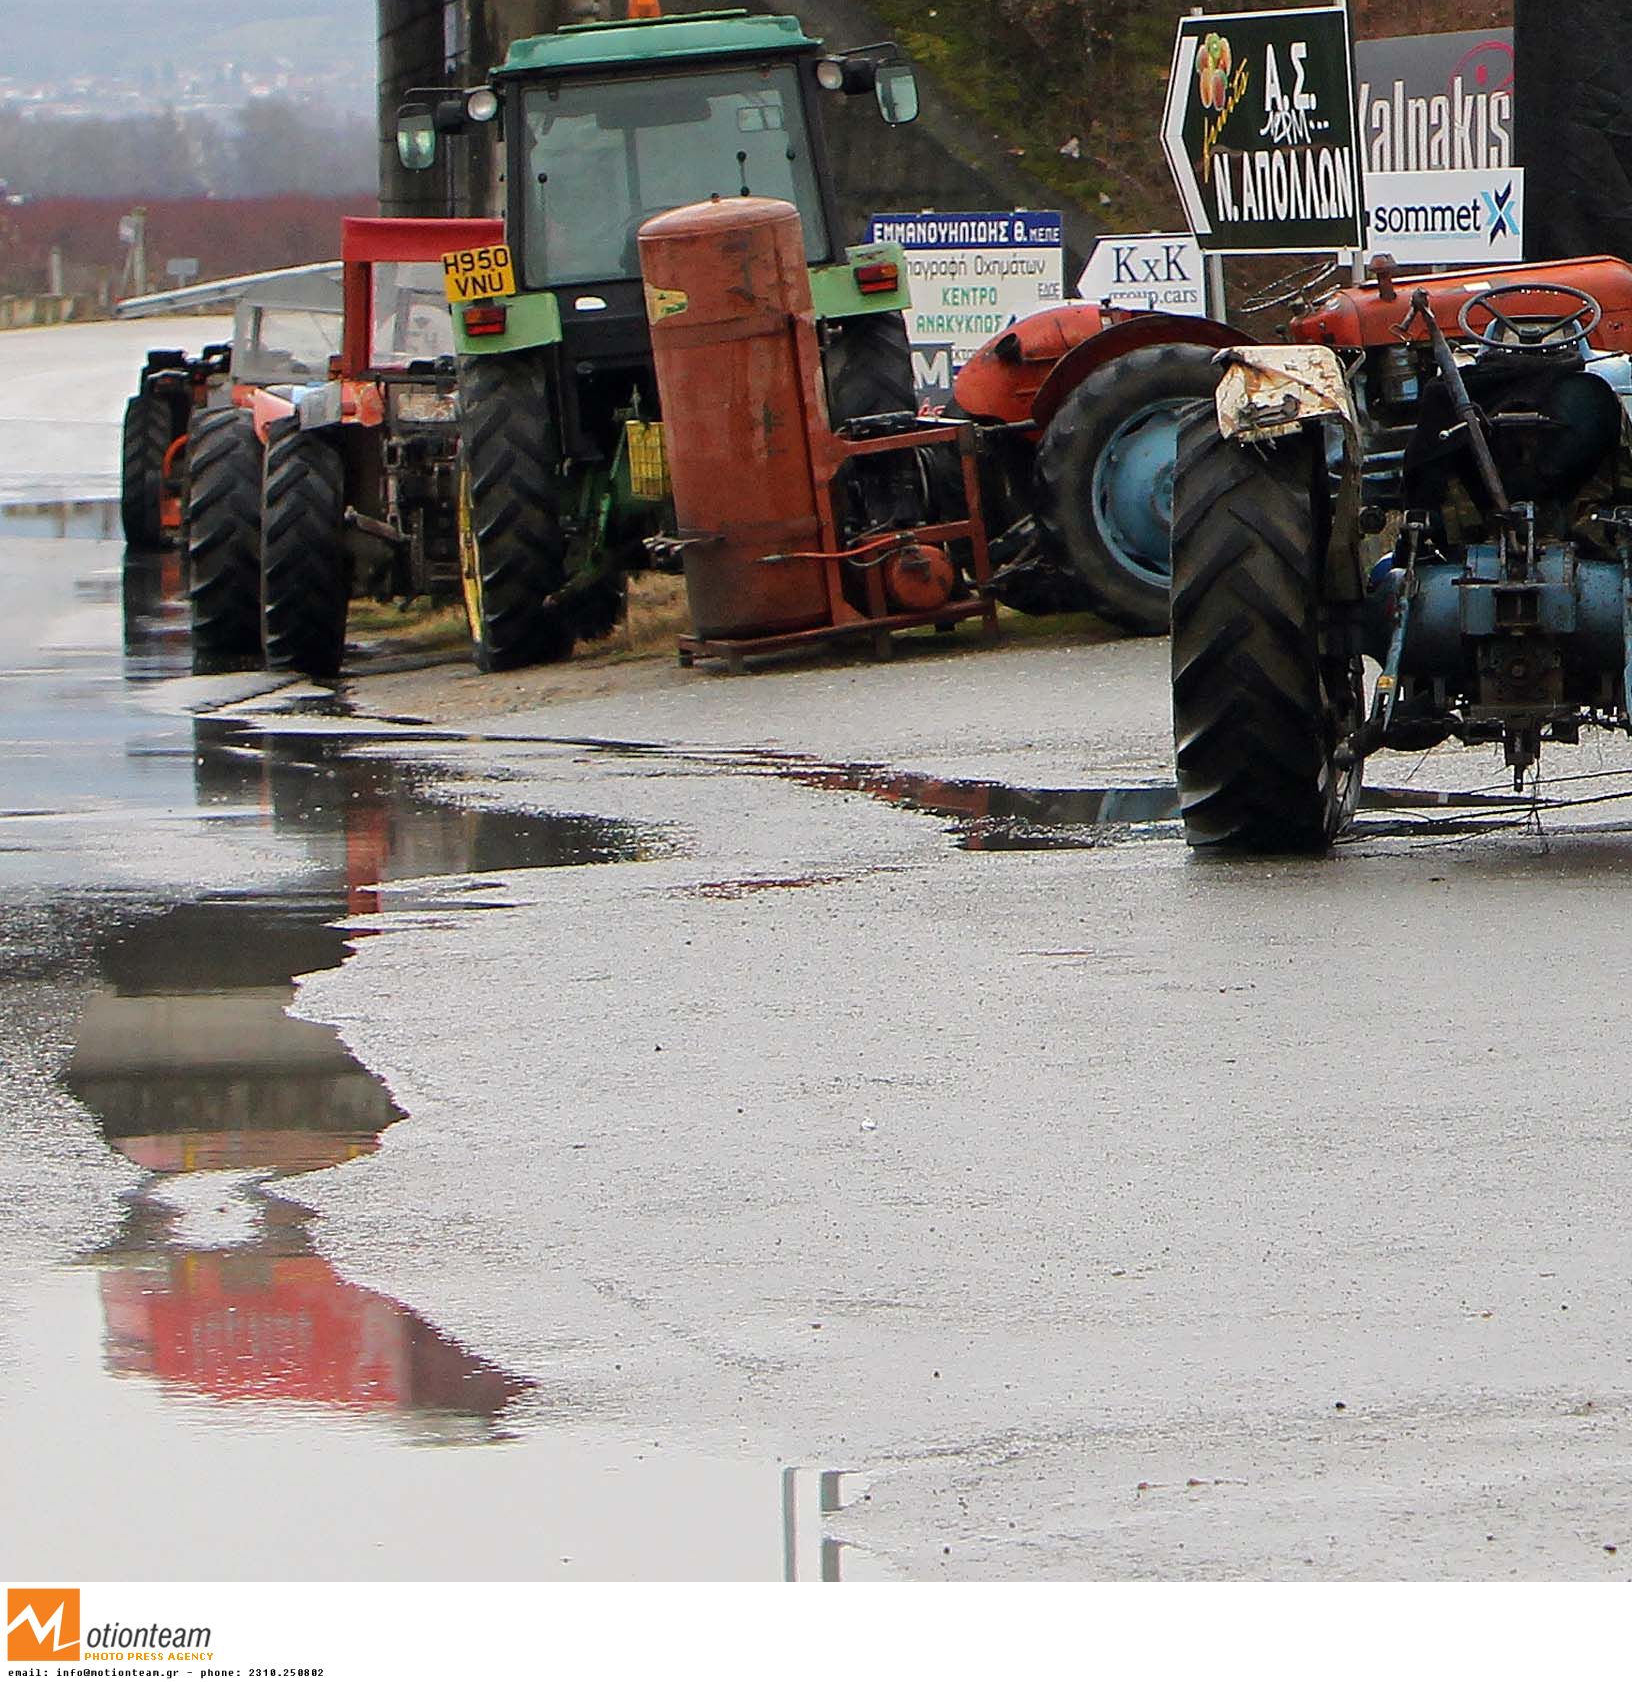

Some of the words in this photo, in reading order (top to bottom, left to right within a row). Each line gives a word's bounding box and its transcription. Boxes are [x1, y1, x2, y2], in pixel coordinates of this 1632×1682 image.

[1243, 147, 1354, 222] ΑΠΟΛΛΩΝ
[443, 247, 509, 275] H950
[455, 271, 504, 297] VNU
[941, 286, 997, 306] ΚΕΝΤΡΟ
